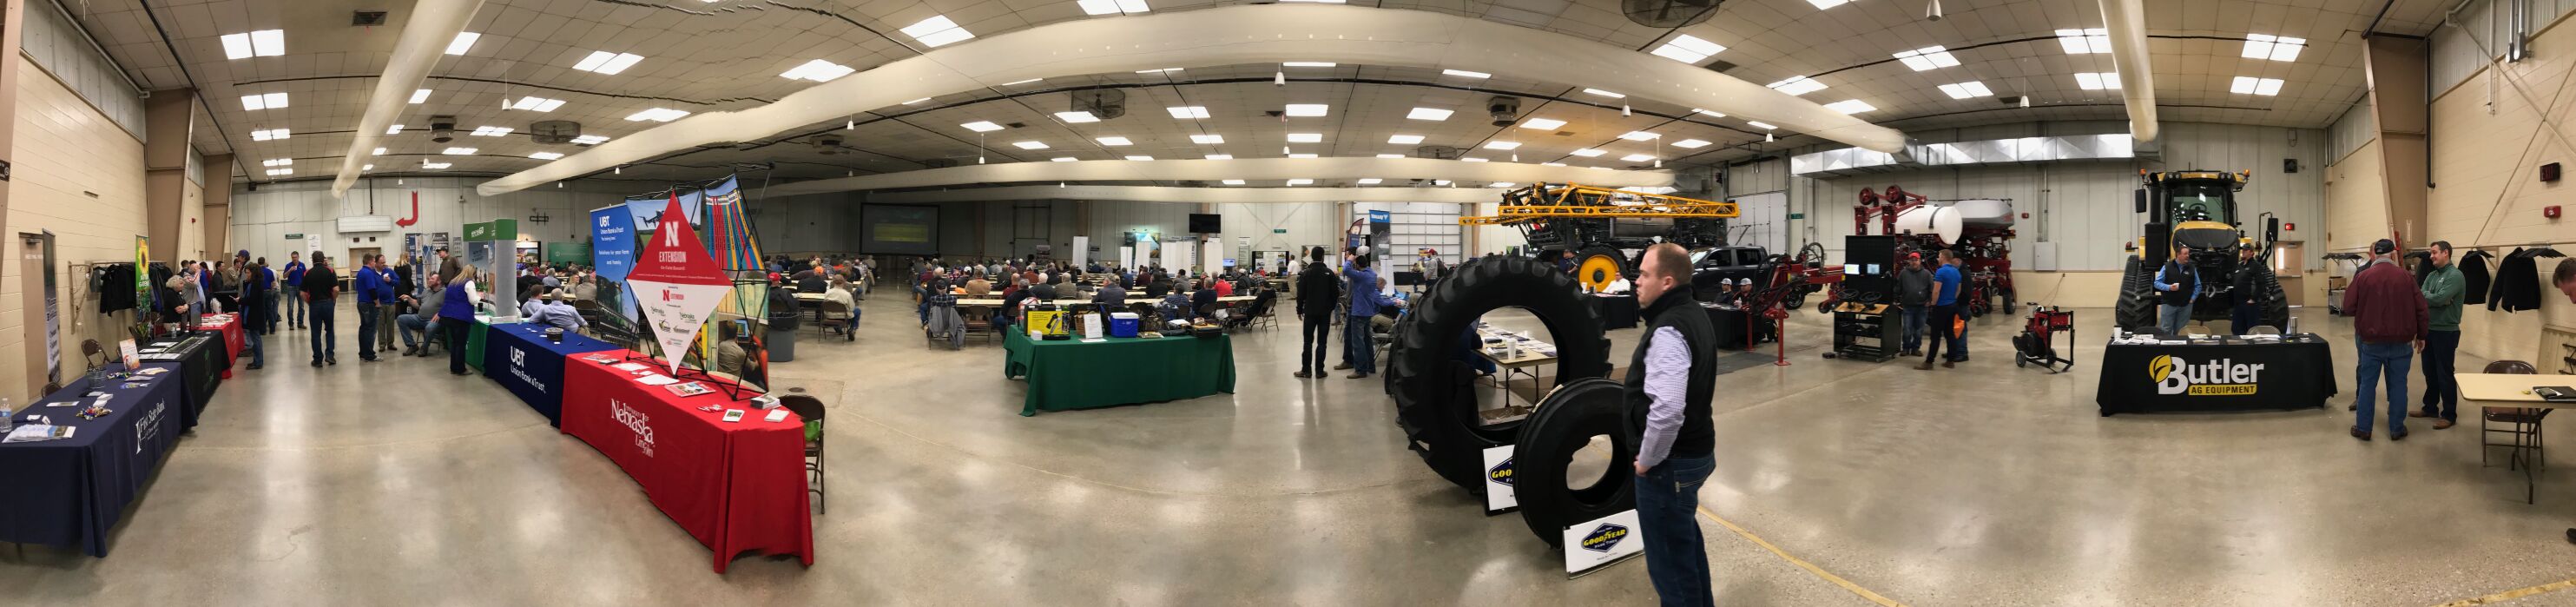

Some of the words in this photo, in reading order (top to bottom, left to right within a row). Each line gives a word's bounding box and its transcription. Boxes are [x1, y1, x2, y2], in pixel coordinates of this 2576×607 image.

[599, 215, 609, 227] UBT
[664, 221, 680, 247] N
[659, 251, 687, 262] EXTENSION
[511, 346, 525, 368] UBT
[511, 364, 522, 378] Union
[521, 370, 531, 383] Bank
[2158, 356, 2264, 394] Butler
[611, 399, 654, 445] Nebraska
[1583, 529, 1626, 546] GOODYEAR
